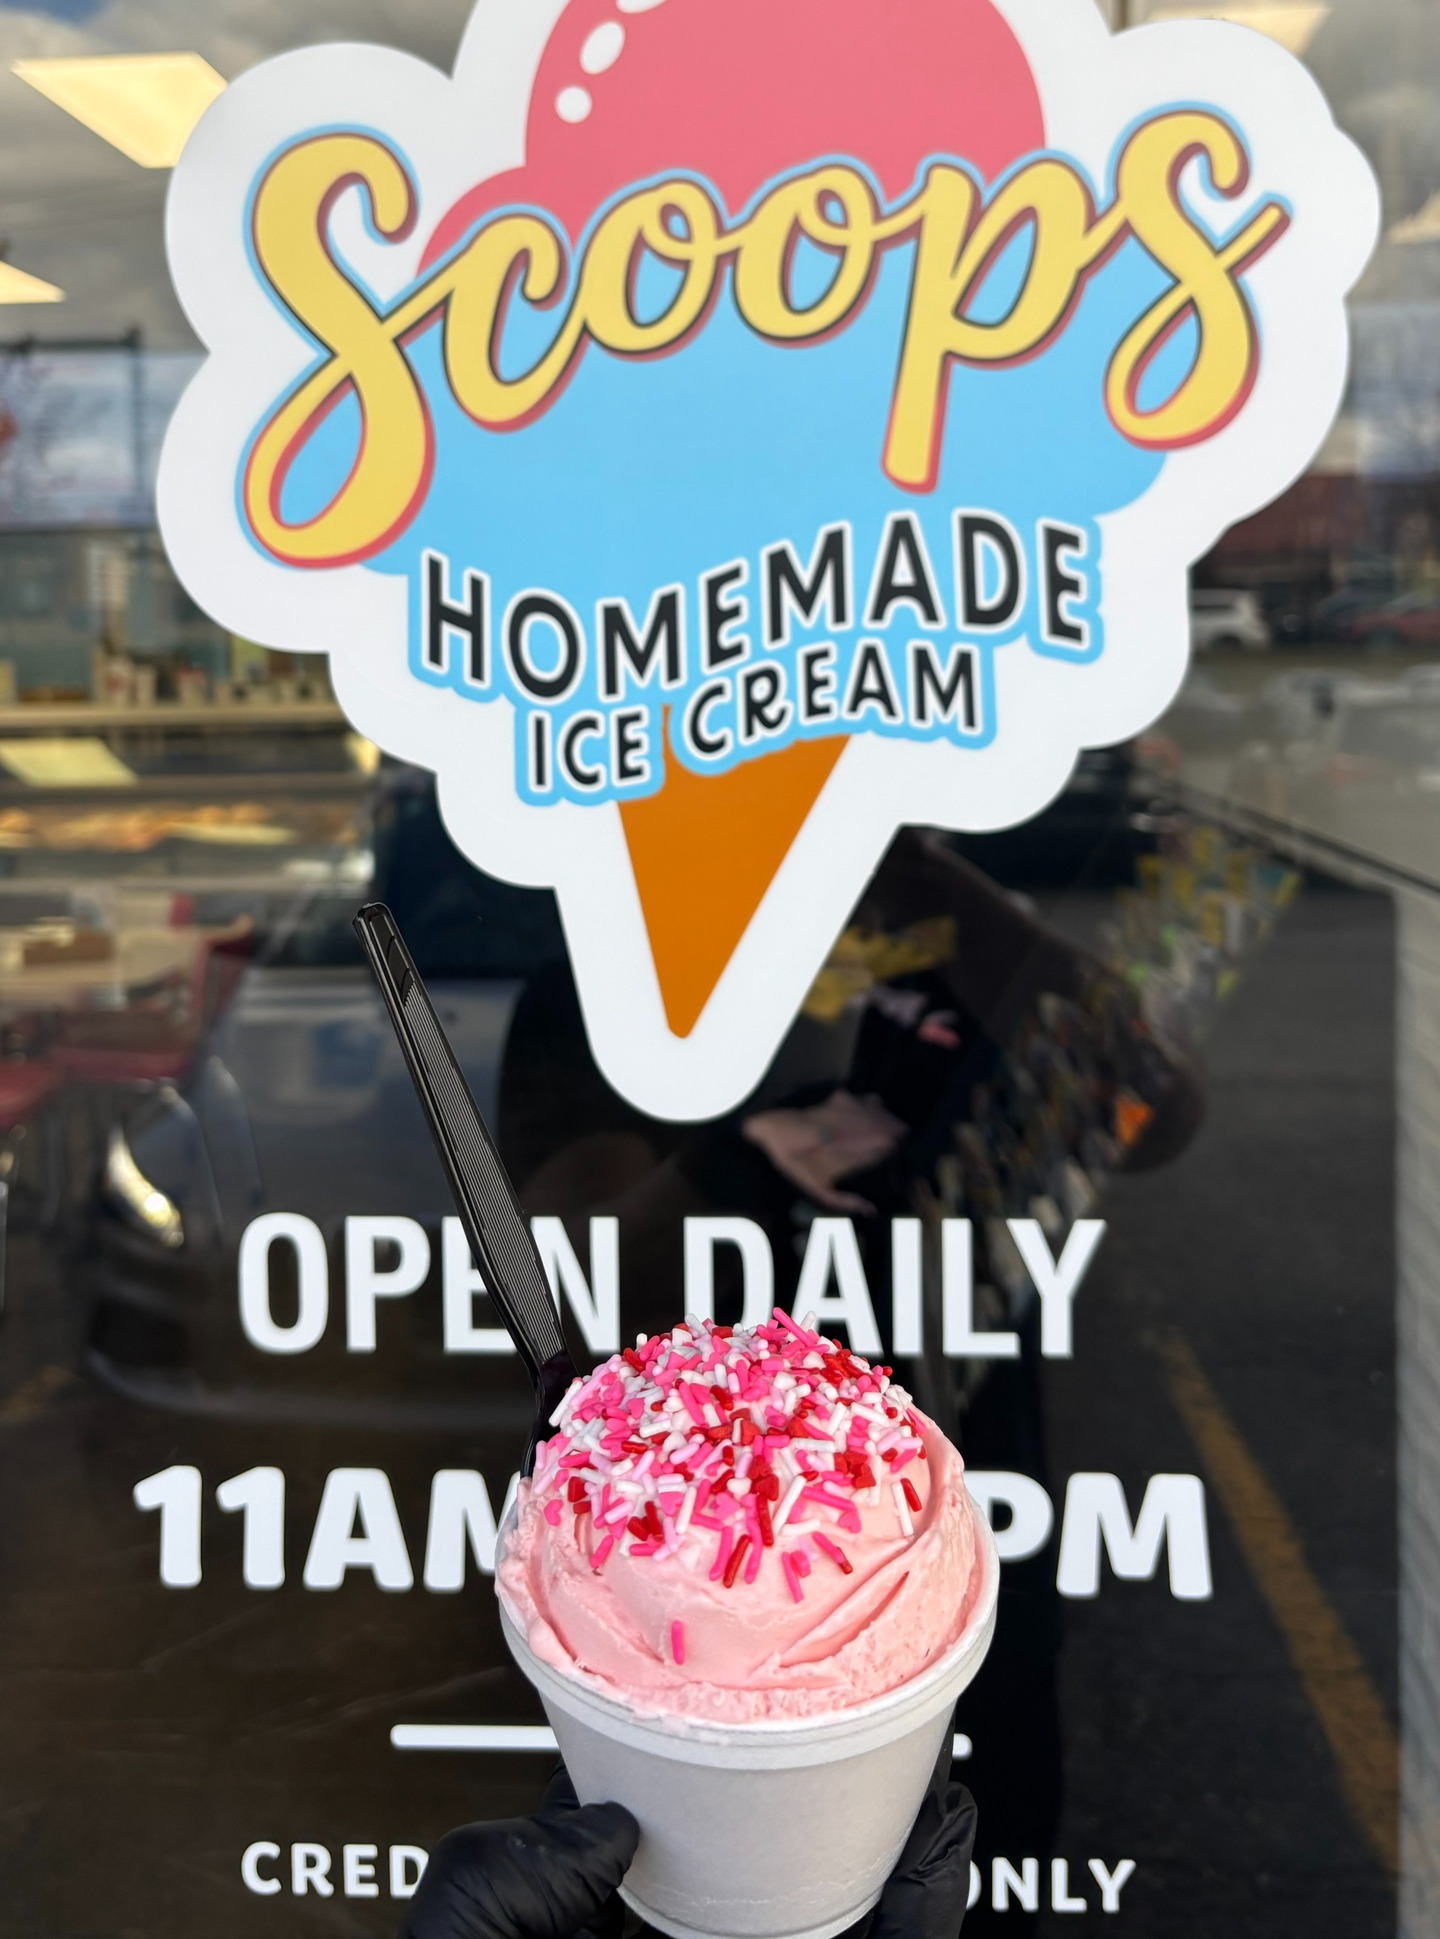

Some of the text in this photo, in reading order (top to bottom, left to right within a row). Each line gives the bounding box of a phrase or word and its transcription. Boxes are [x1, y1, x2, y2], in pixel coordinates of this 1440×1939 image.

[244, 110, 1289, 568] Scoops
[423, 513, 1088, 700] HOMEMADE
[531, 644, 981, 789] ICE CREAM
[238, 1212, 1106, 1358] OPEN DAILY
[965, 1856, 1137, 1913] NLY
